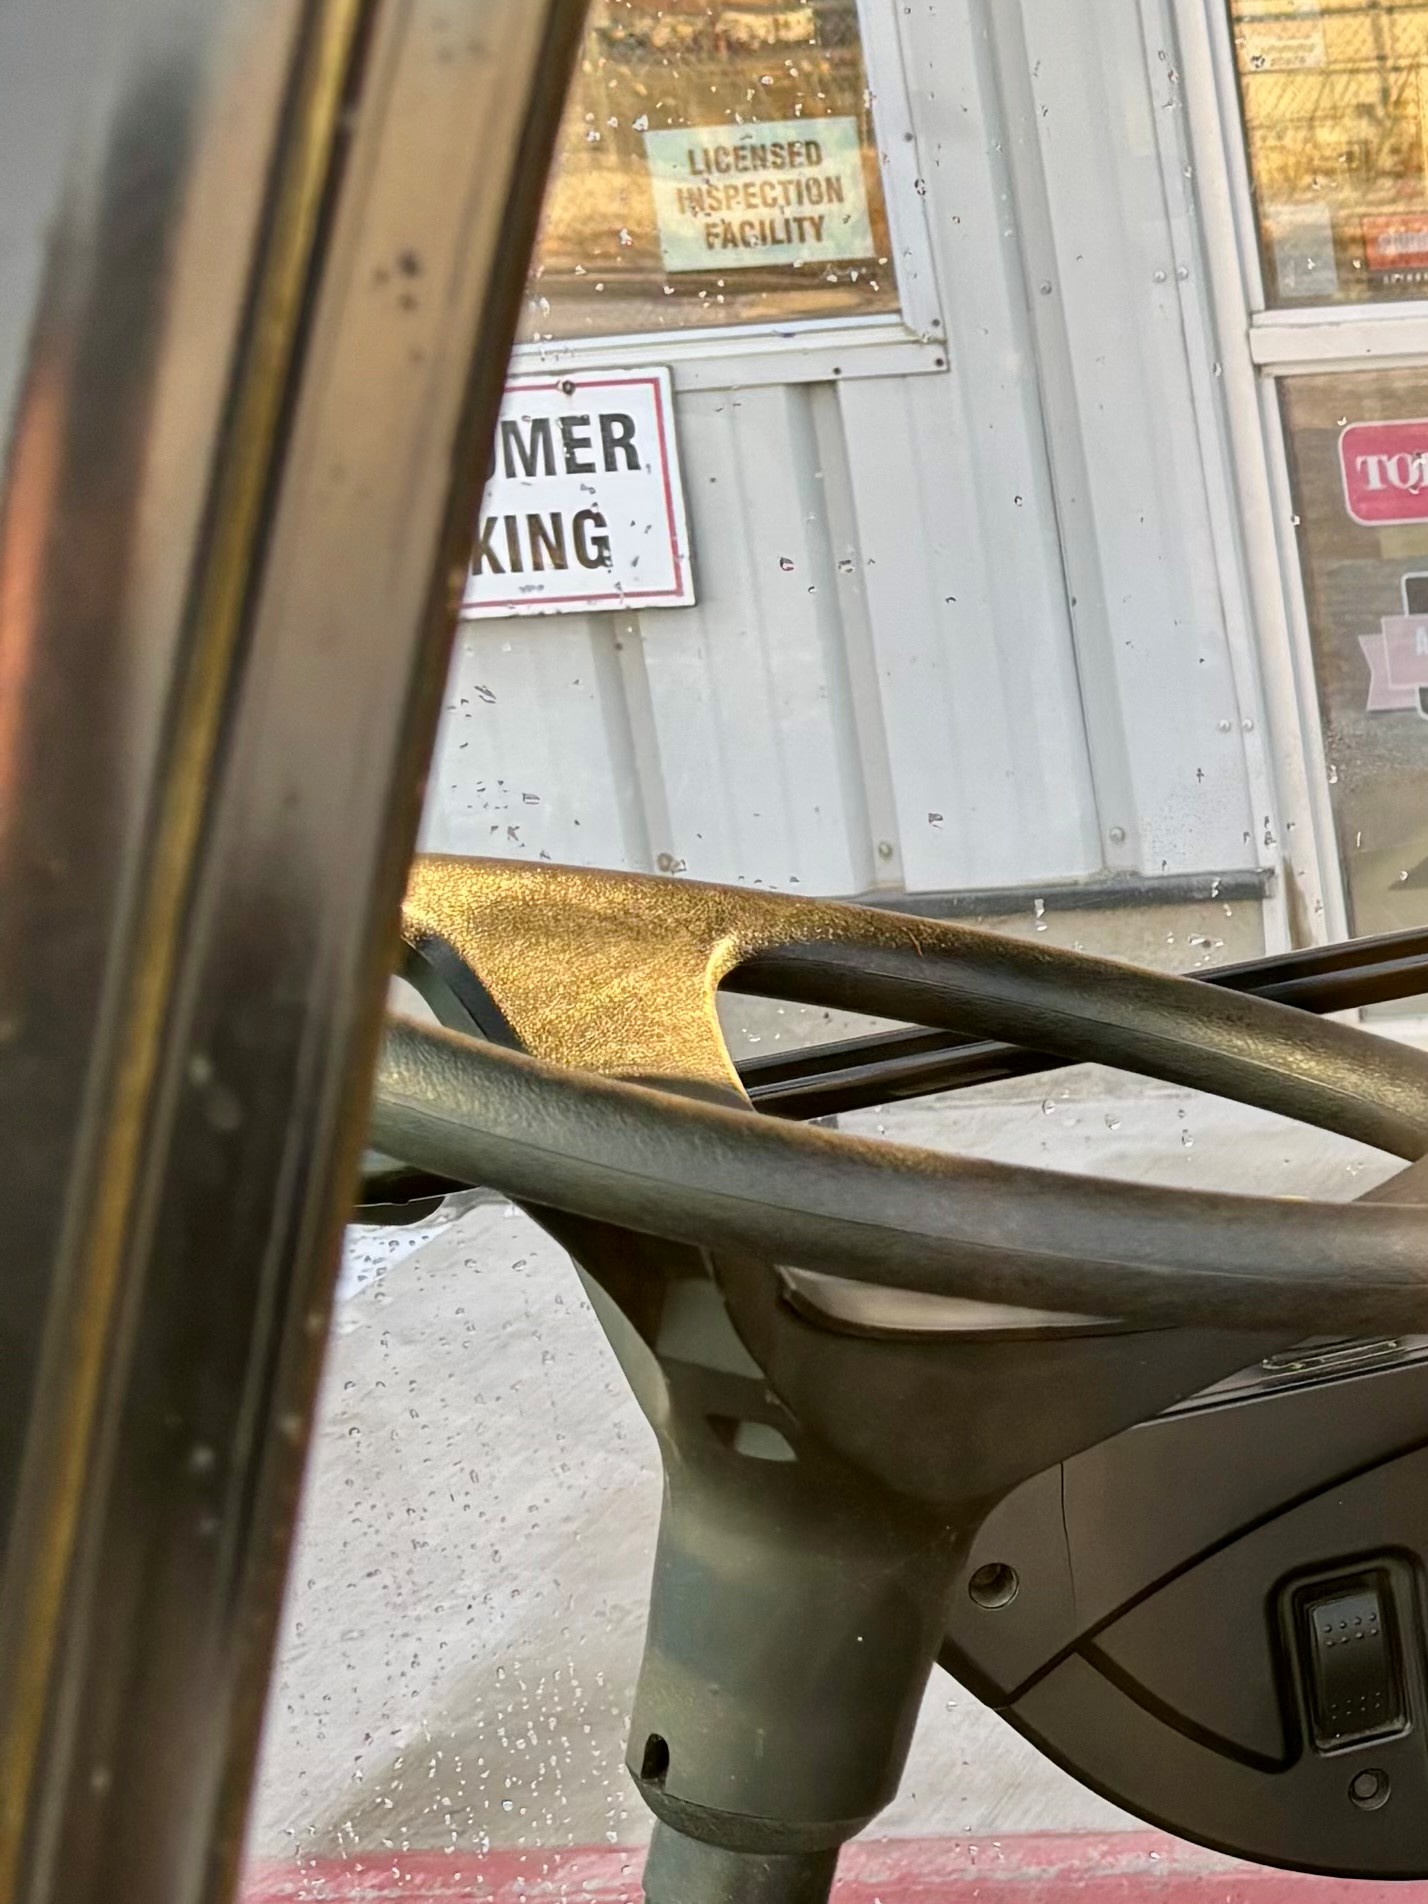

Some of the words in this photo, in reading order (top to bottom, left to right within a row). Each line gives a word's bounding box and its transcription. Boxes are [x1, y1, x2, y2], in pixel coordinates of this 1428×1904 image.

[687, 140, 823, 176] LICENSED
[676, 175, 845, 215] INSPECTION
[704, 214, 826, 251] FACILITY
